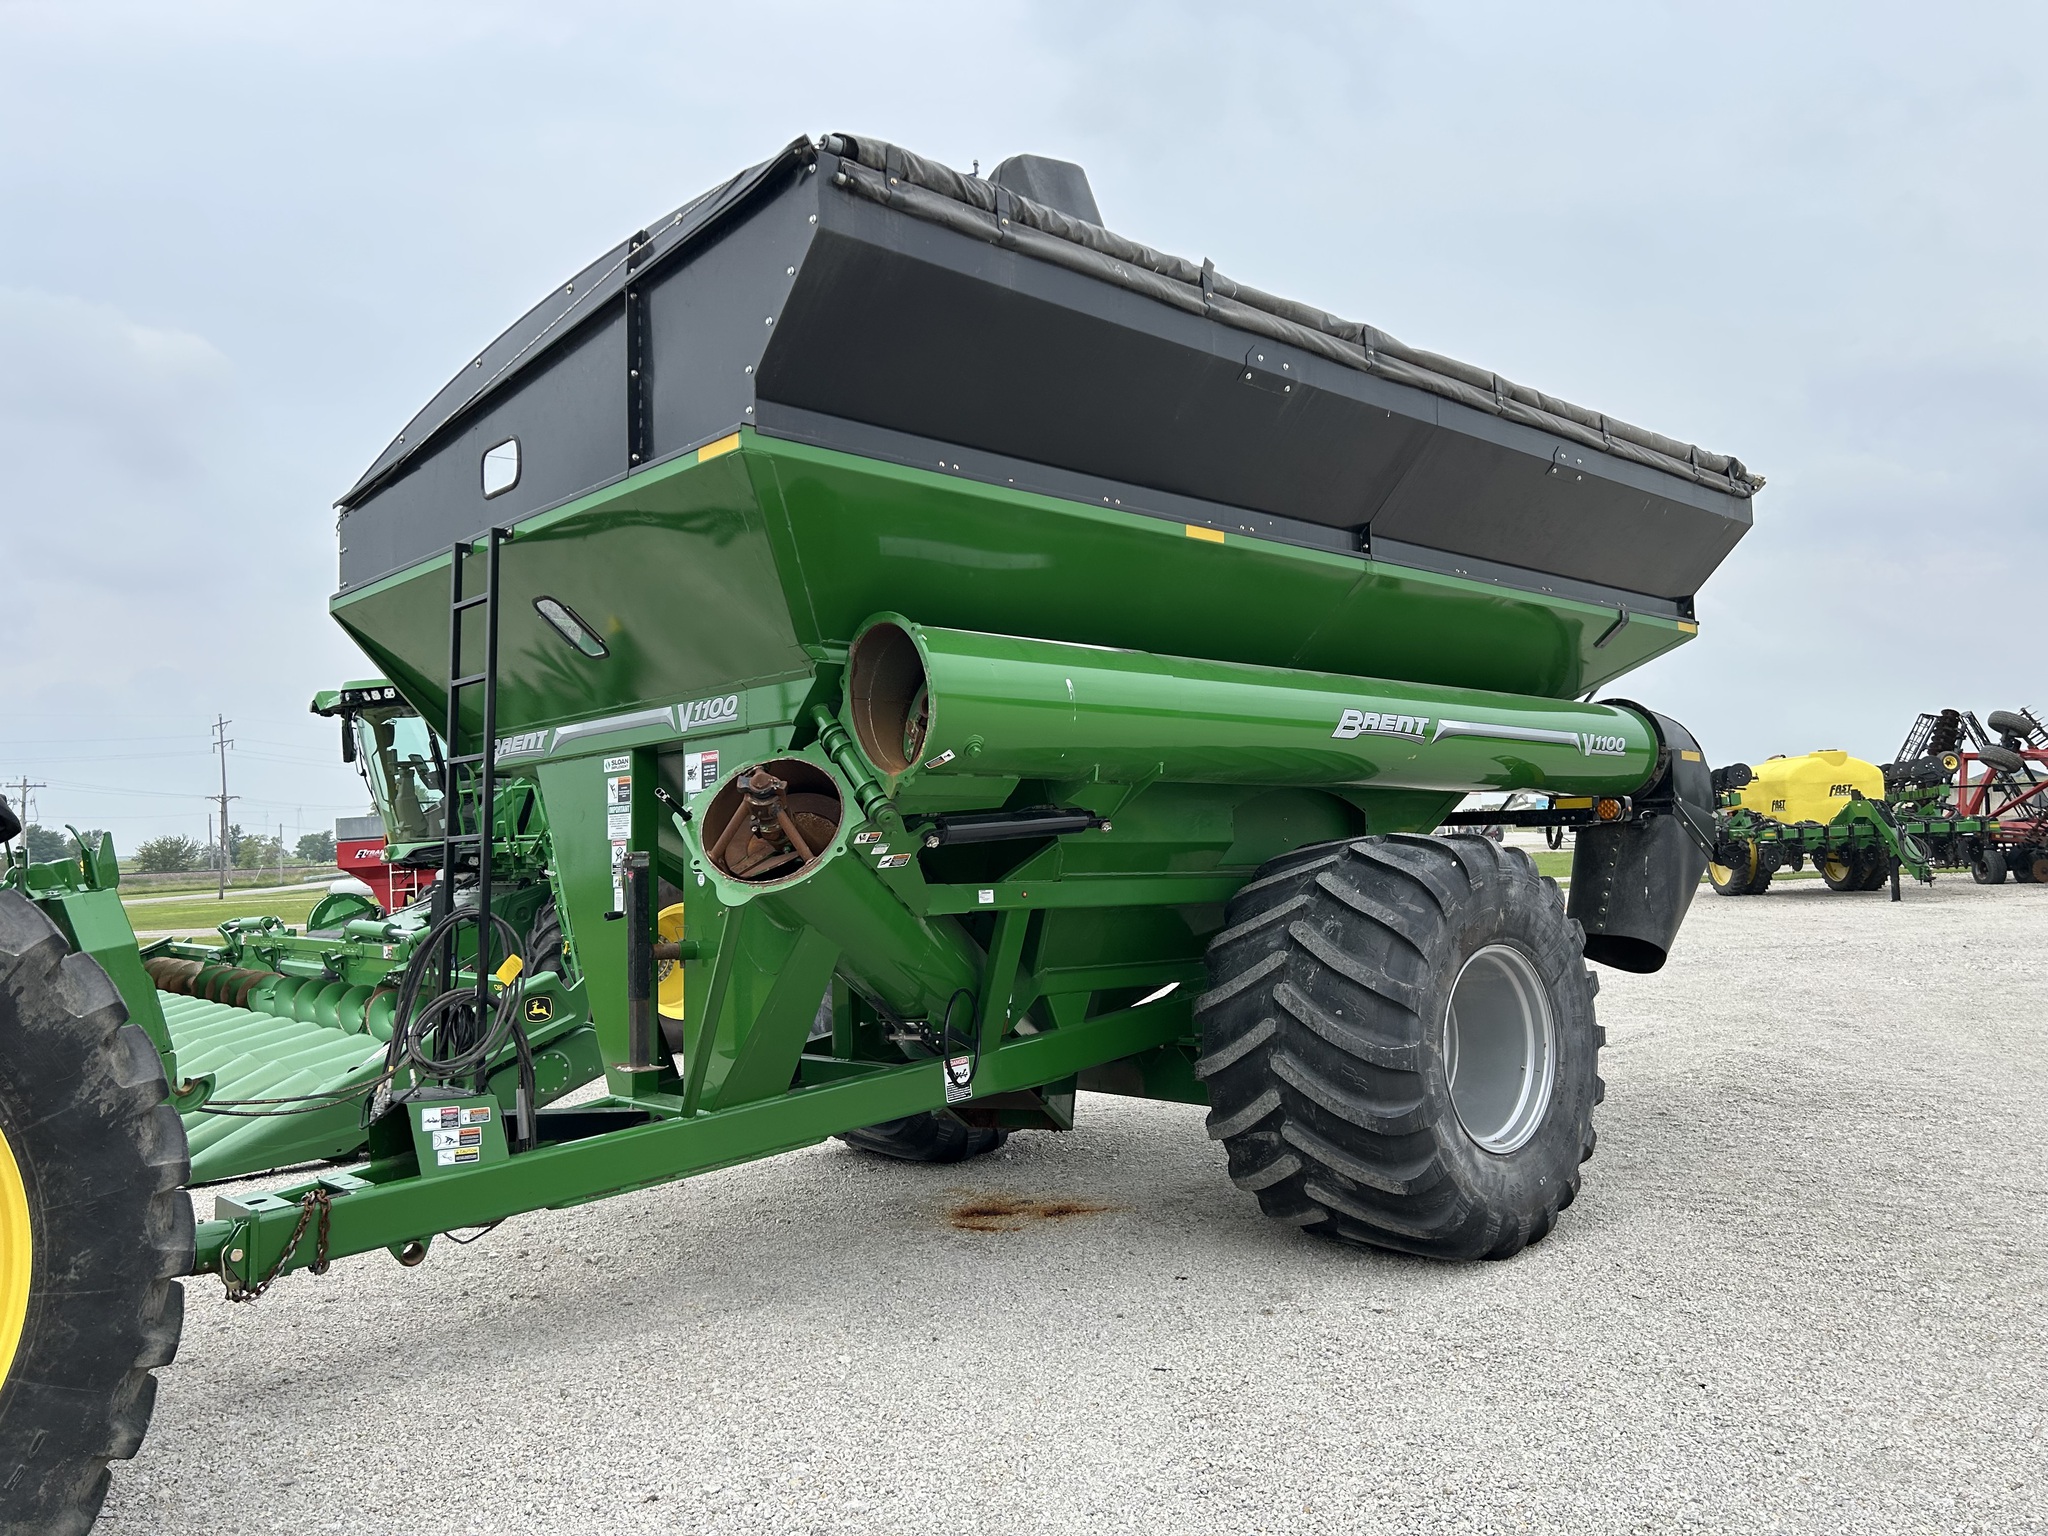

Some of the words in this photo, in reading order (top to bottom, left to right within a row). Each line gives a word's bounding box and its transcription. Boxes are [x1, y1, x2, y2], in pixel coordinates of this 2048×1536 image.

[677, 695, 738, 733] V1100
[1331, 708, 1430, 744] BRENT
[1582, 733, 1626, 757] V1100
[611, 758, 629, 766] SLOAN
[1829, 784, 1852, 797] FAST
[1771, 800, 1785, 812] FAST
